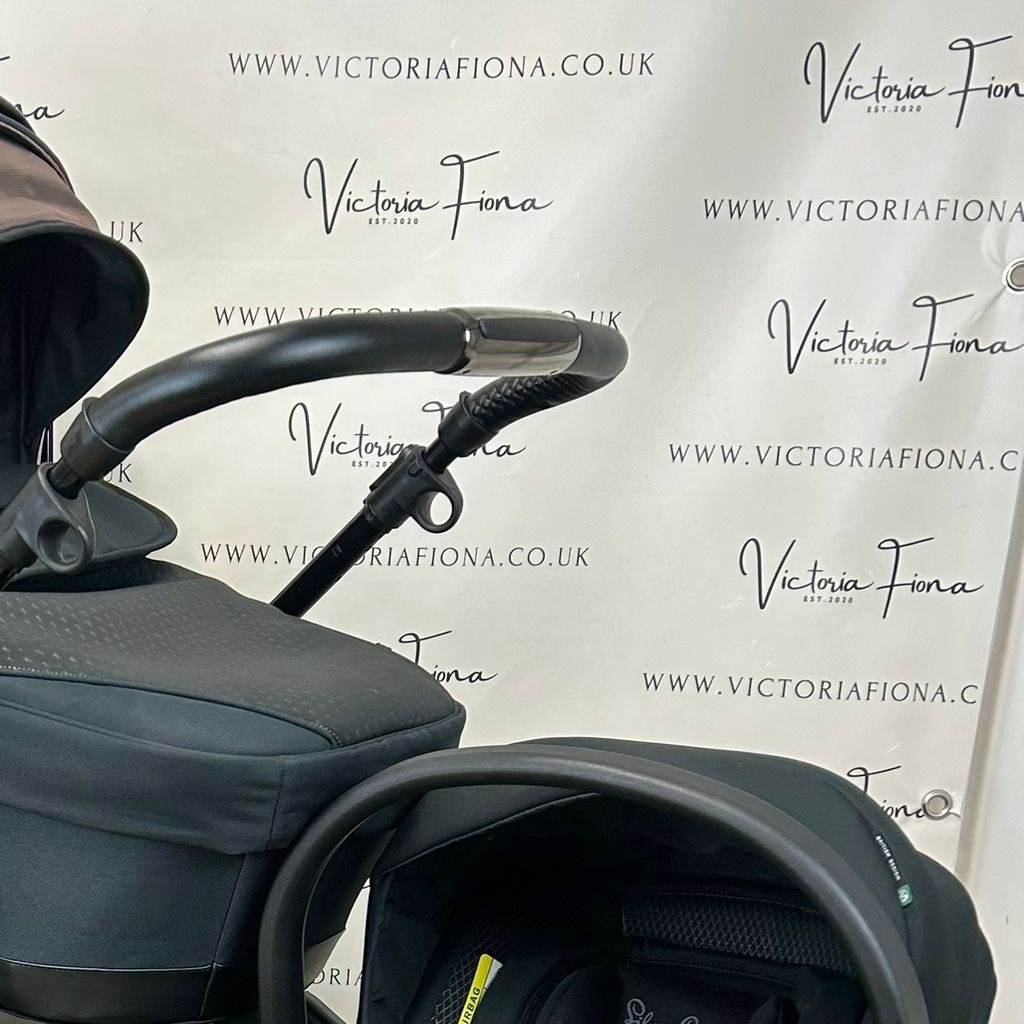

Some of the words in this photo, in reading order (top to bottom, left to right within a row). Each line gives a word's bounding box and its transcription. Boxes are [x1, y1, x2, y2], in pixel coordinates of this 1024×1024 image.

[228, 52, 655, 80] WWW.VICTORIAFIONA.CO.UK
[804, 41, 945, 124] Victoria
[303, 157, 439, 236] Victoria
[440, 150, 554, 241] Fiona
[368, 217, 419, 225] EST.2020
[767, 298, 909, 375] Victoria
[912, 293, 1024, 382] Fiona
[739, 537, 875, 611] Victoria
[876, 536, 985, 620] Fiona
